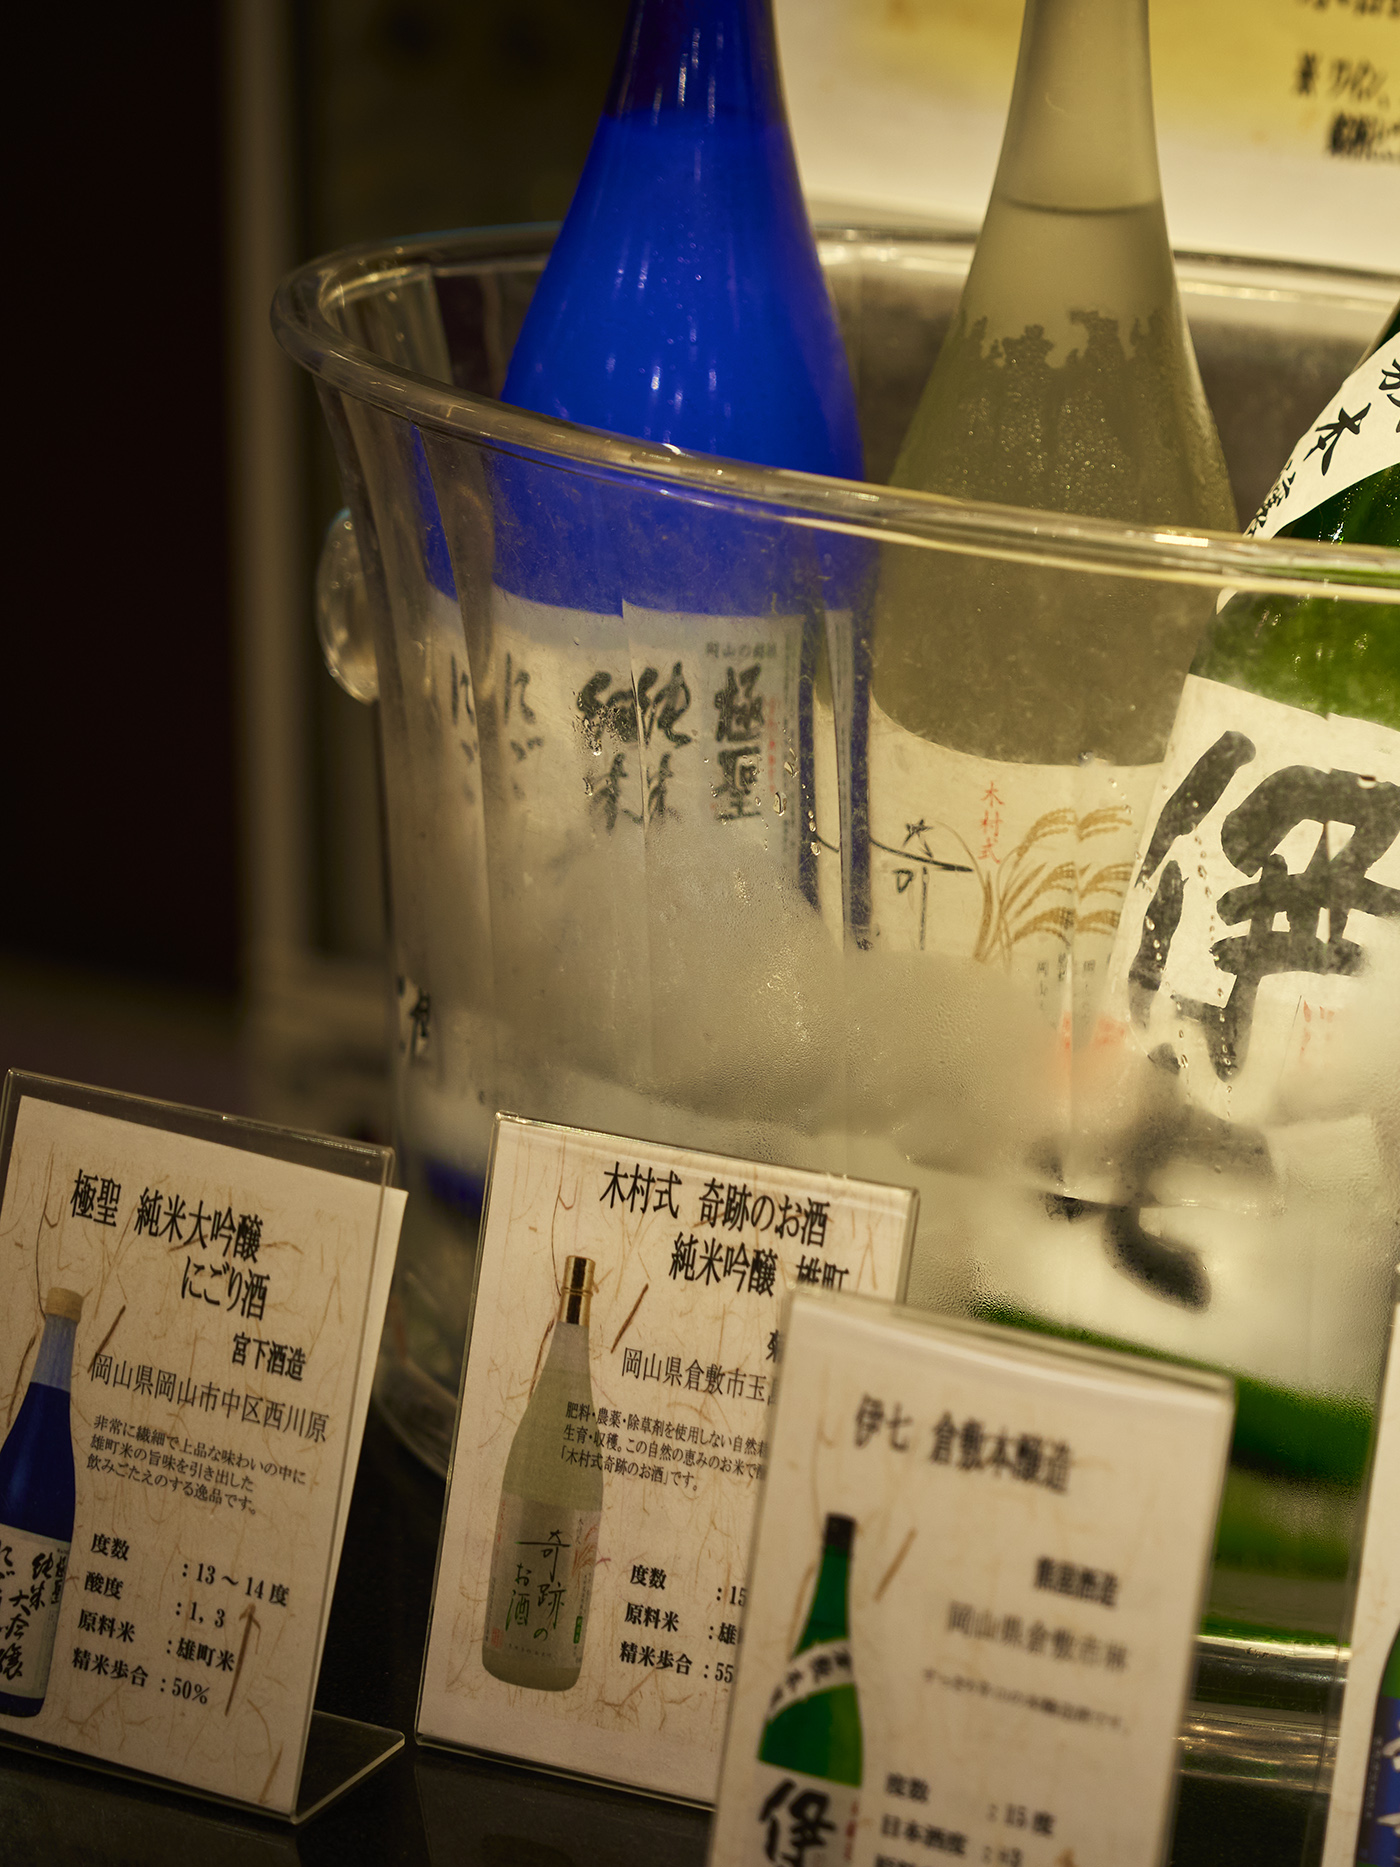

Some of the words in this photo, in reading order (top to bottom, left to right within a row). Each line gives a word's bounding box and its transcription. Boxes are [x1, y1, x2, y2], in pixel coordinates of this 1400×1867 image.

[70, 1168, 122, 1228] 極聖
[133, 1186, 264, 1264] 純米大吟醸
[600, 1160, 683, 1219] 木村式
[698, 1177, 832, 1248] 奇跡のお酒
[180, 1256, 270, 1322] にごり酒
[668, 1231, 779, 1297] 純米吟醸
[231, 1331, 307, 1382] 宮下酒造
[621, 1347, 776, 1405] 岡山県倉敷市玉
[90, 1352, 330, 1444] 岡山県岡山市中区西川原
[90, 1434, 255, 1493] 雄町米の旨味を引き出した
[93, 1414, 307, 1486] 非常に繊細で上品な味わいの中に
[560, 1446, 699, 1492] 「木村式奇跡のお酒」です。
[86, 1453, 257, 1516] 飲みごたえのする逸品です。
[90, 1532, 131, 1562] 度数
[83, 1570, 124, 1600] 酸度
[630, 1564, 667, 1591] 度数
[77, 1608, 136, 1644] 原料米
[625, 1602, 680, 1633] 原料米
[71, 1646, 149, 1688] 精米歩合
[619, 1640, 693, 1676] 精米歩合
